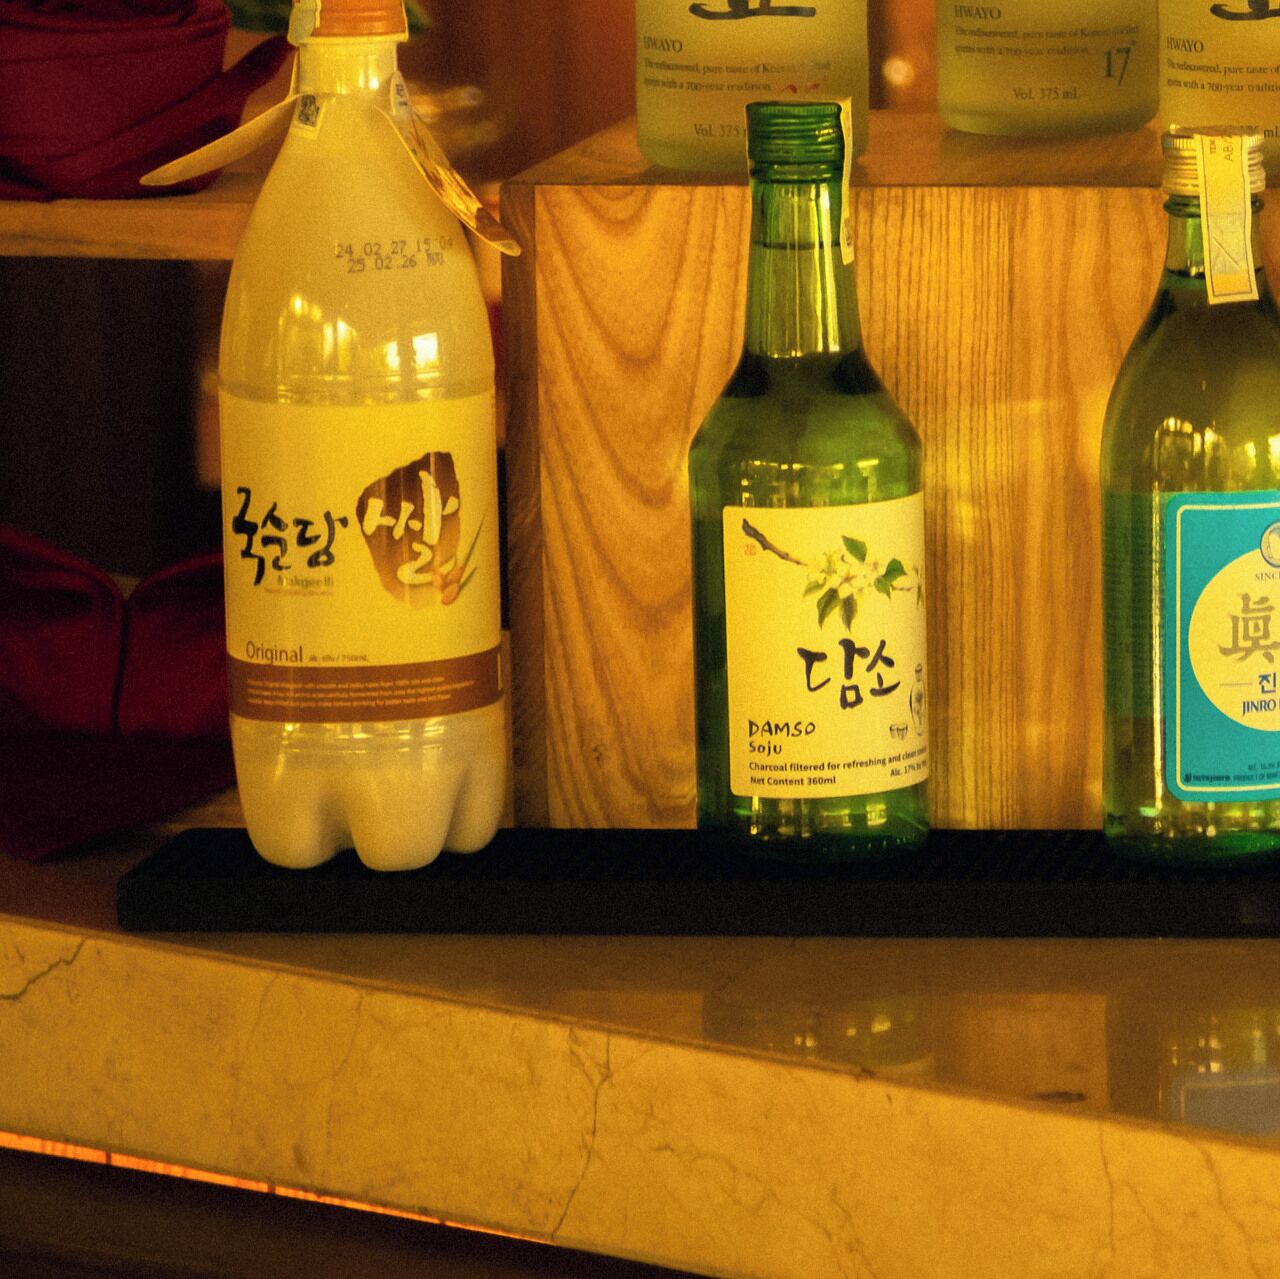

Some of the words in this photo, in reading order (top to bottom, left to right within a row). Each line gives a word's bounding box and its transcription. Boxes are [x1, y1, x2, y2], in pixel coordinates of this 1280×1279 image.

[1166, 36, 1205, 53] HWAYO
[231, 486, 348, 588] 국순당
[362, 470, 460, 586] 쌀
[246, 640, 303, 665] Original
[796, 637, 901, 710] 담소
[1242, 698, 1277, 718] JINRO
[748, 719, 817, 738] DAMSO
[749, 740, 783, 757] Soju
[749, 761, 788, 772] Charcoal
[789, 760, 825, 772] filtered
[827, 760, 841, 771] for
[842, 756, 887, 770] refreshing
[887, 753, 901, 764] and
[750, 775, 766, 786] Net
[767, 775, 805, 786] Content
[806, 775, 837, 786] 360ml
